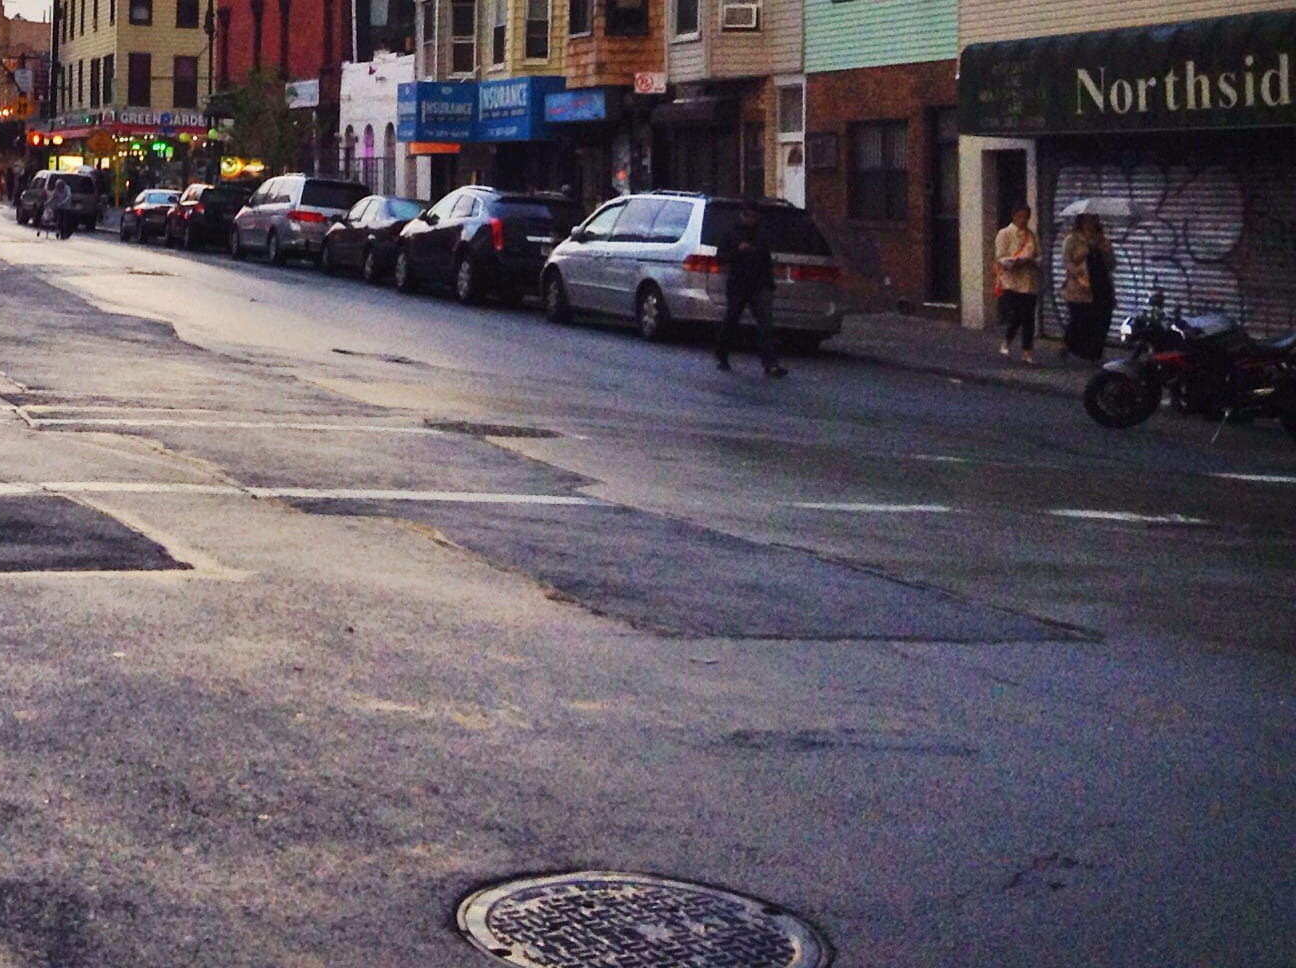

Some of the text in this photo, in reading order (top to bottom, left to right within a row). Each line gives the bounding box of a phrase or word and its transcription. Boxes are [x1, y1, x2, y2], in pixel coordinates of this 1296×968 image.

[479, 83, 527, 121] INSURANCE
[1075, 52, 1292, 115] Northsid
[120, 112, 216, 127] GREEN ARDE
